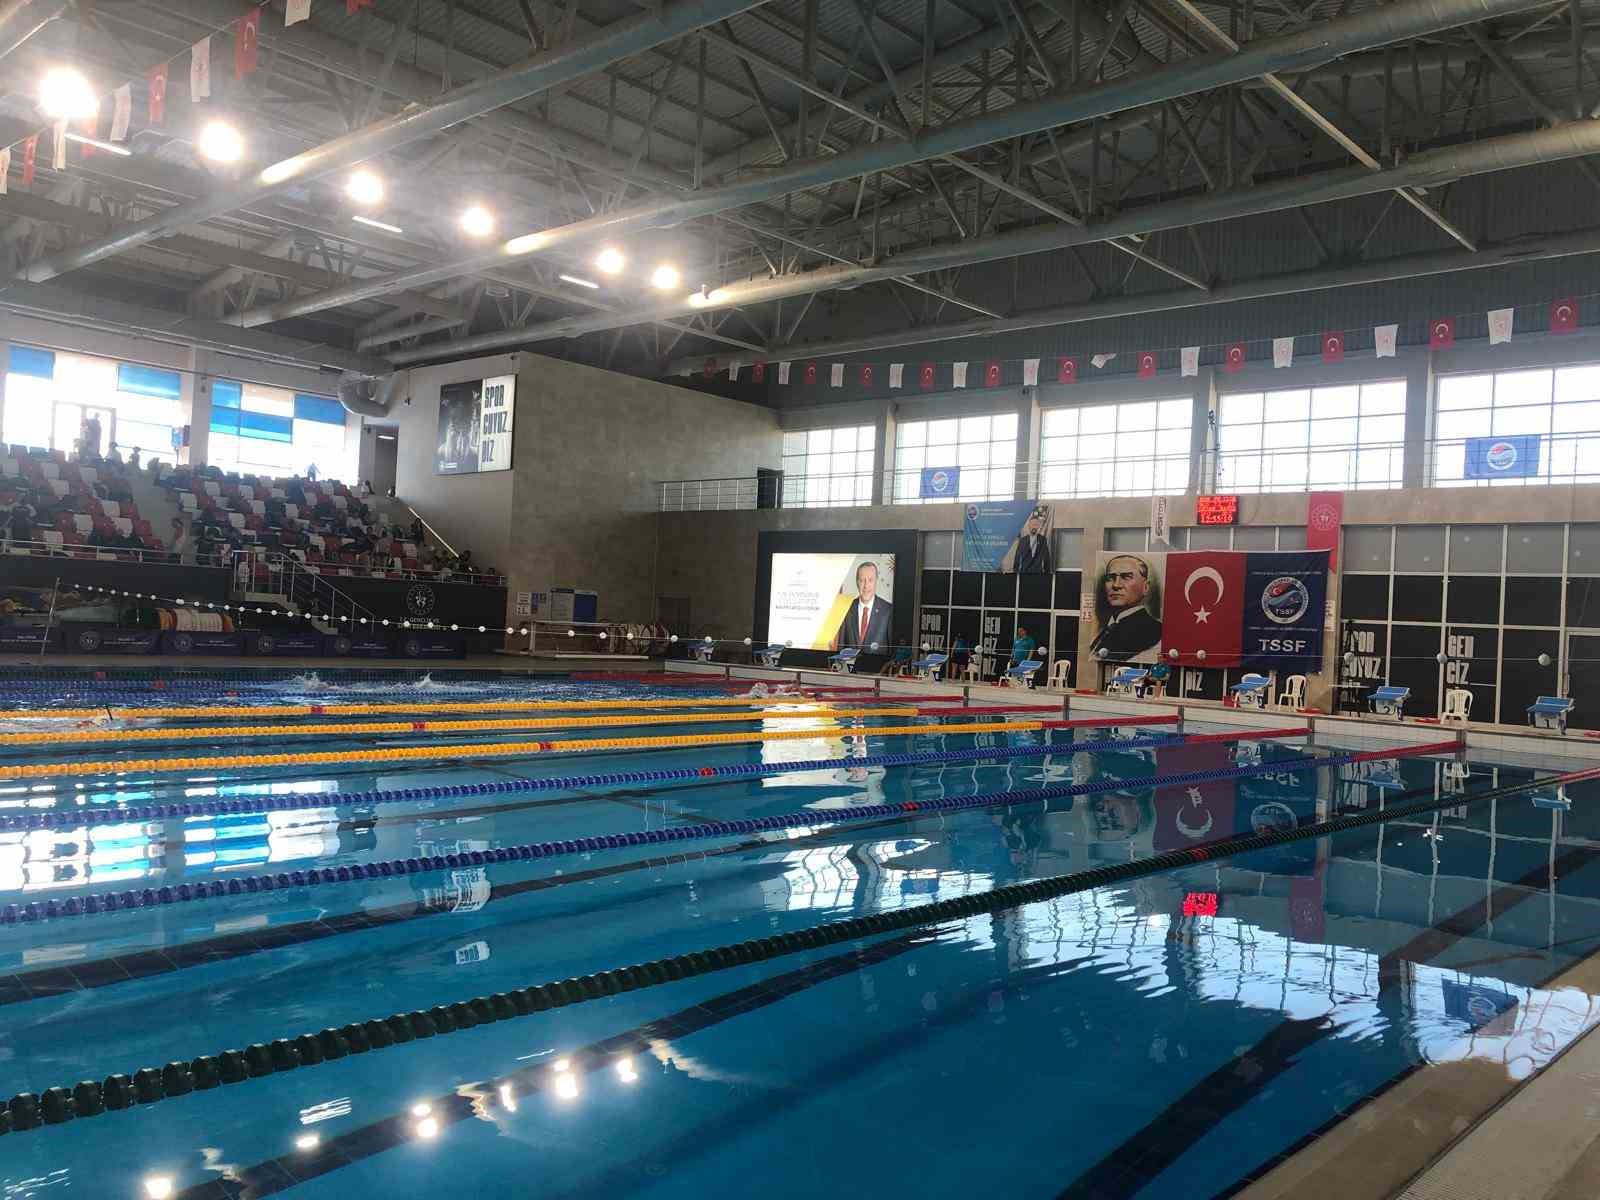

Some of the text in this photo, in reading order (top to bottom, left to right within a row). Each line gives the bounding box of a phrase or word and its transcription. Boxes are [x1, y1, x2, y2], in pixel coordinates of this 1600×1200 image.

[484, 385, 504, 408] SPOR
[921, 615, 941, 631] SPOR
[1259, 639, 1306, 653] TSSF
[1448, 635, 1474, 657] GEN
